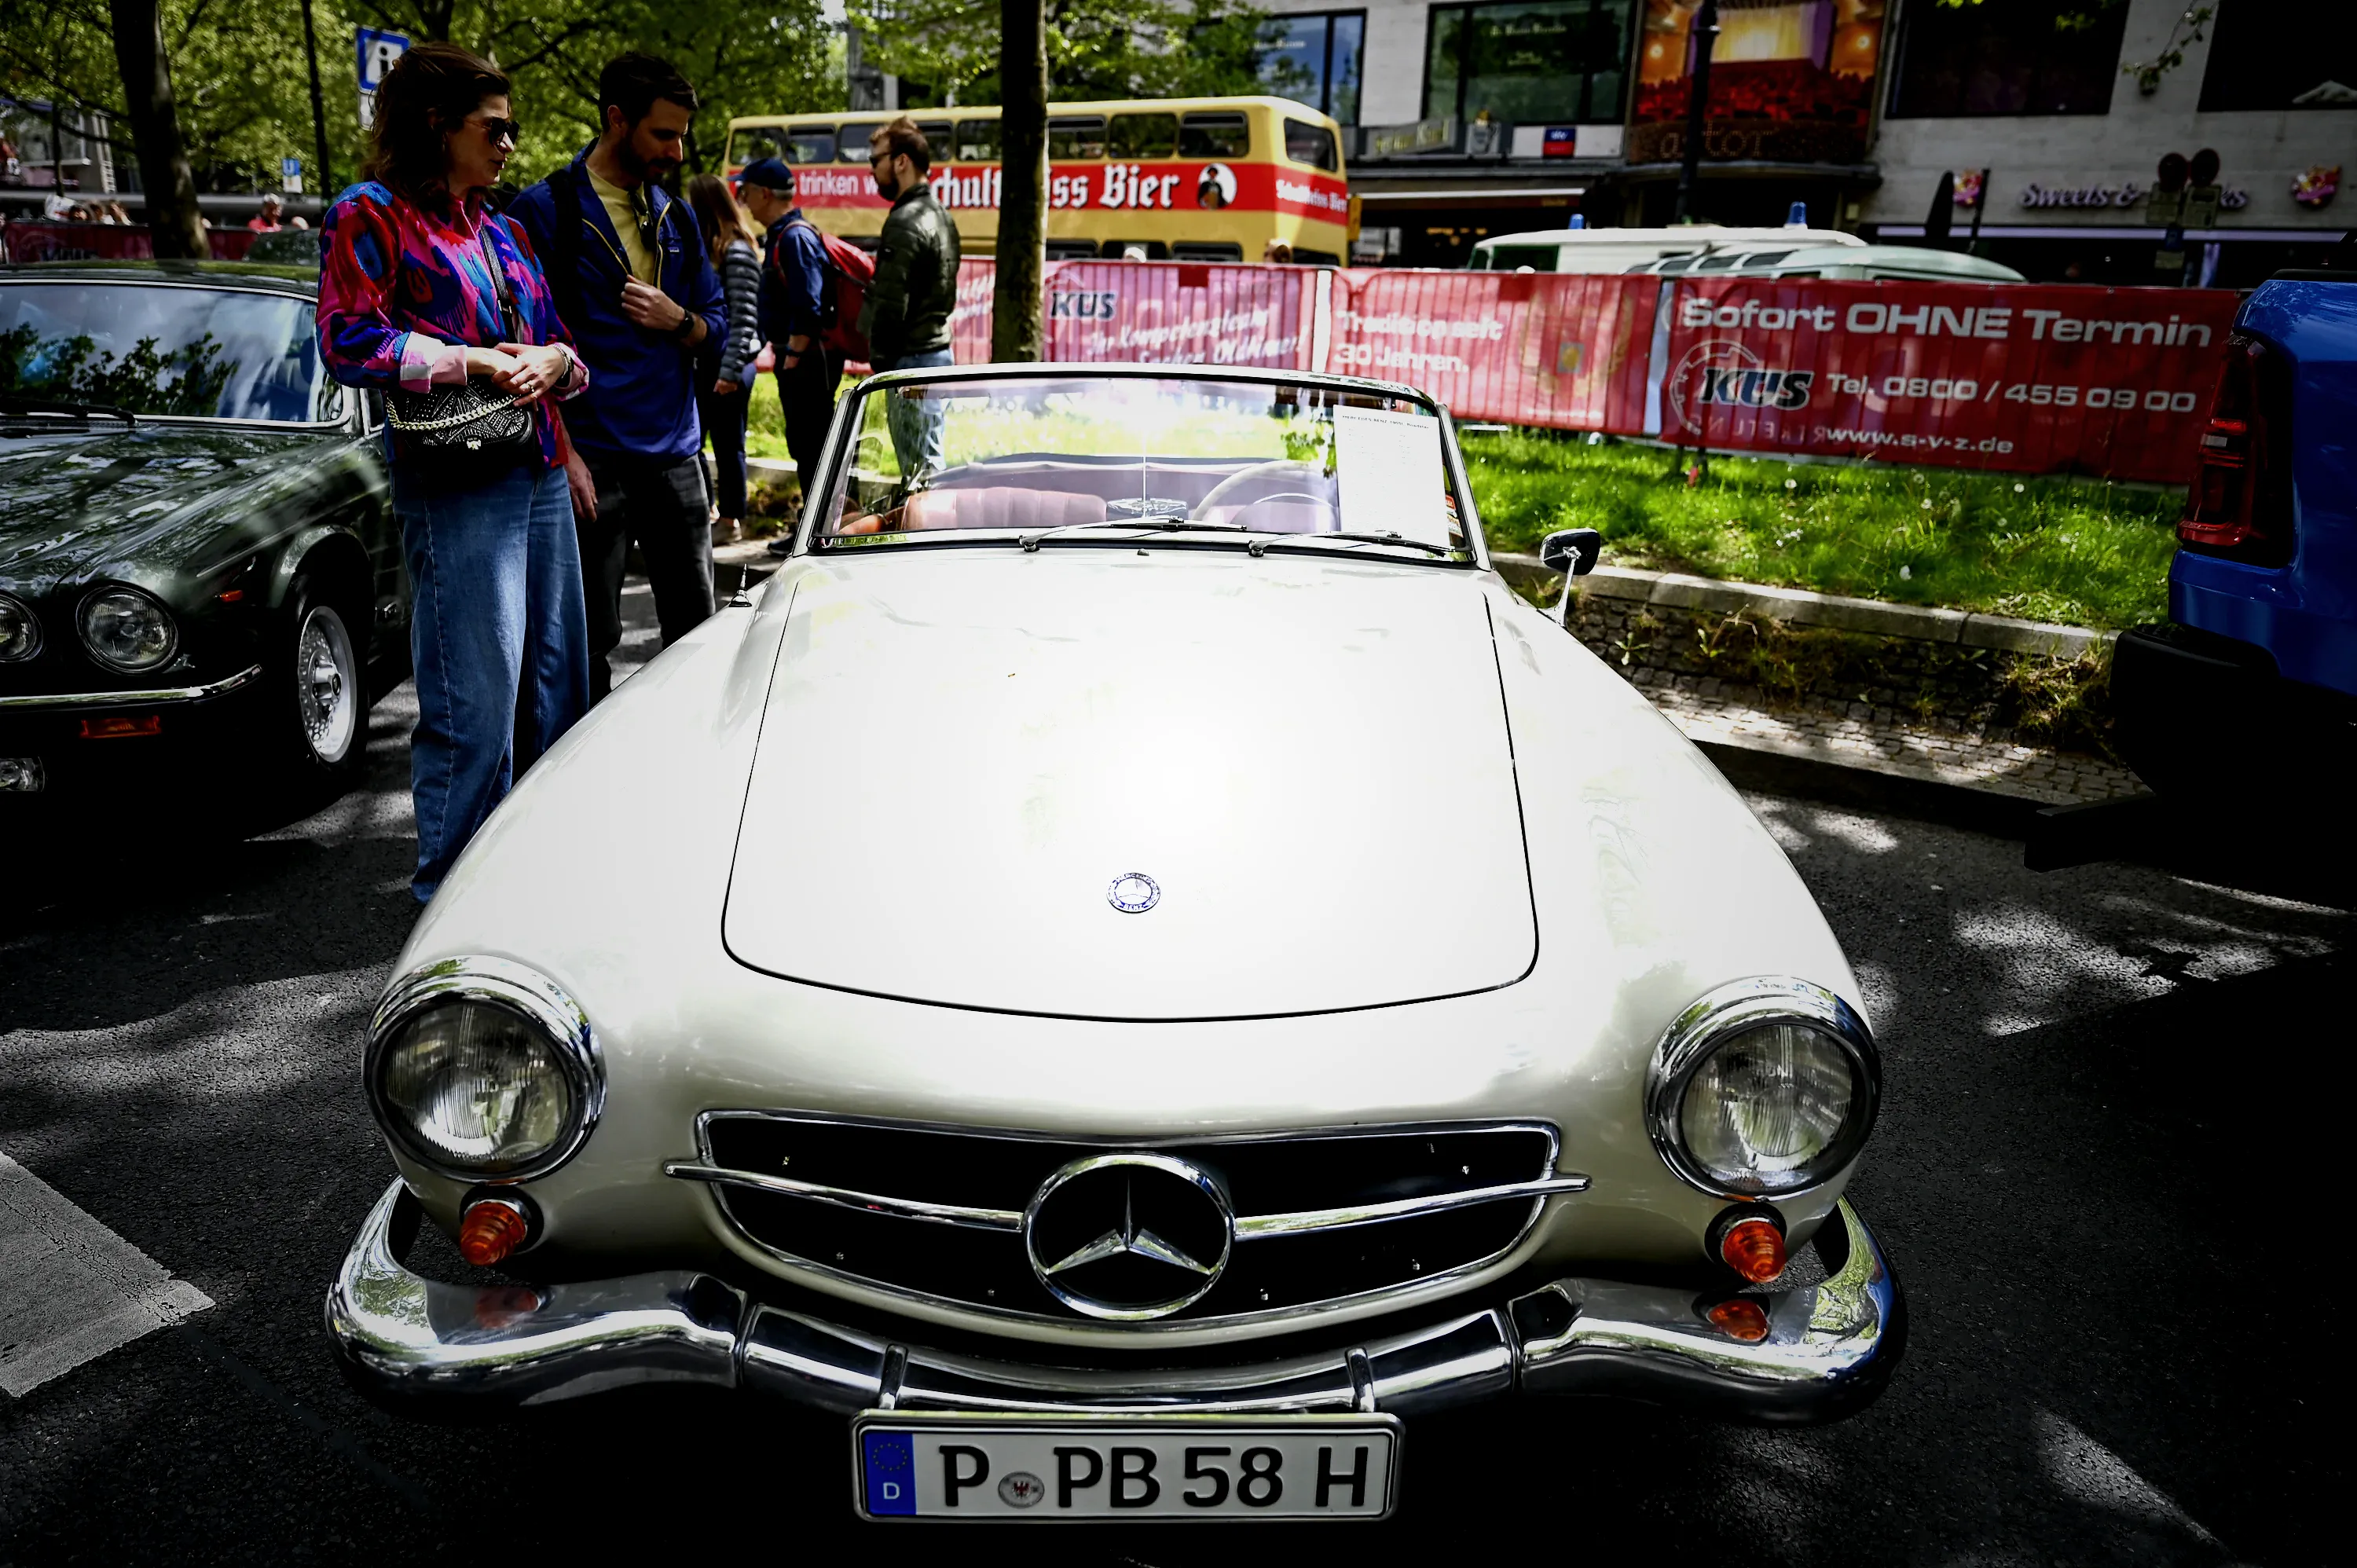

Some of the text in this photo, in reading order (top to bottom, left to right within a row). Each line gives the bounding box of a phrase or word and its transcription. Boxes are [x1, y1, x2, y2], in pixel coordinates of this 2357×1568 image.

[1659, 119, 1780, 158] ator
[799, 170, 859, 196] trinken
[1098, 163, 1181, 209] Bier
[2022, 182, 2110, 208] Sweets
[1682, 297, 2212, 348] Sofort OHNE Termin
[1334, 343, 1470, 373] 30 Jahren.
[1826, 372, 1875, 395] Tel.
[1882, 376, 1978, 401] 0800
[2004, 383, 2079, 407] 455
[2085, 387, 2138, 409] 09
[2143, 390, 2197, 413] 00
[1827, 427, 2014, 454] www.s-v-z.de
[882, 1482, 900, 1500] D
[939, 1445, 1369, 1509] P PB 58 H
